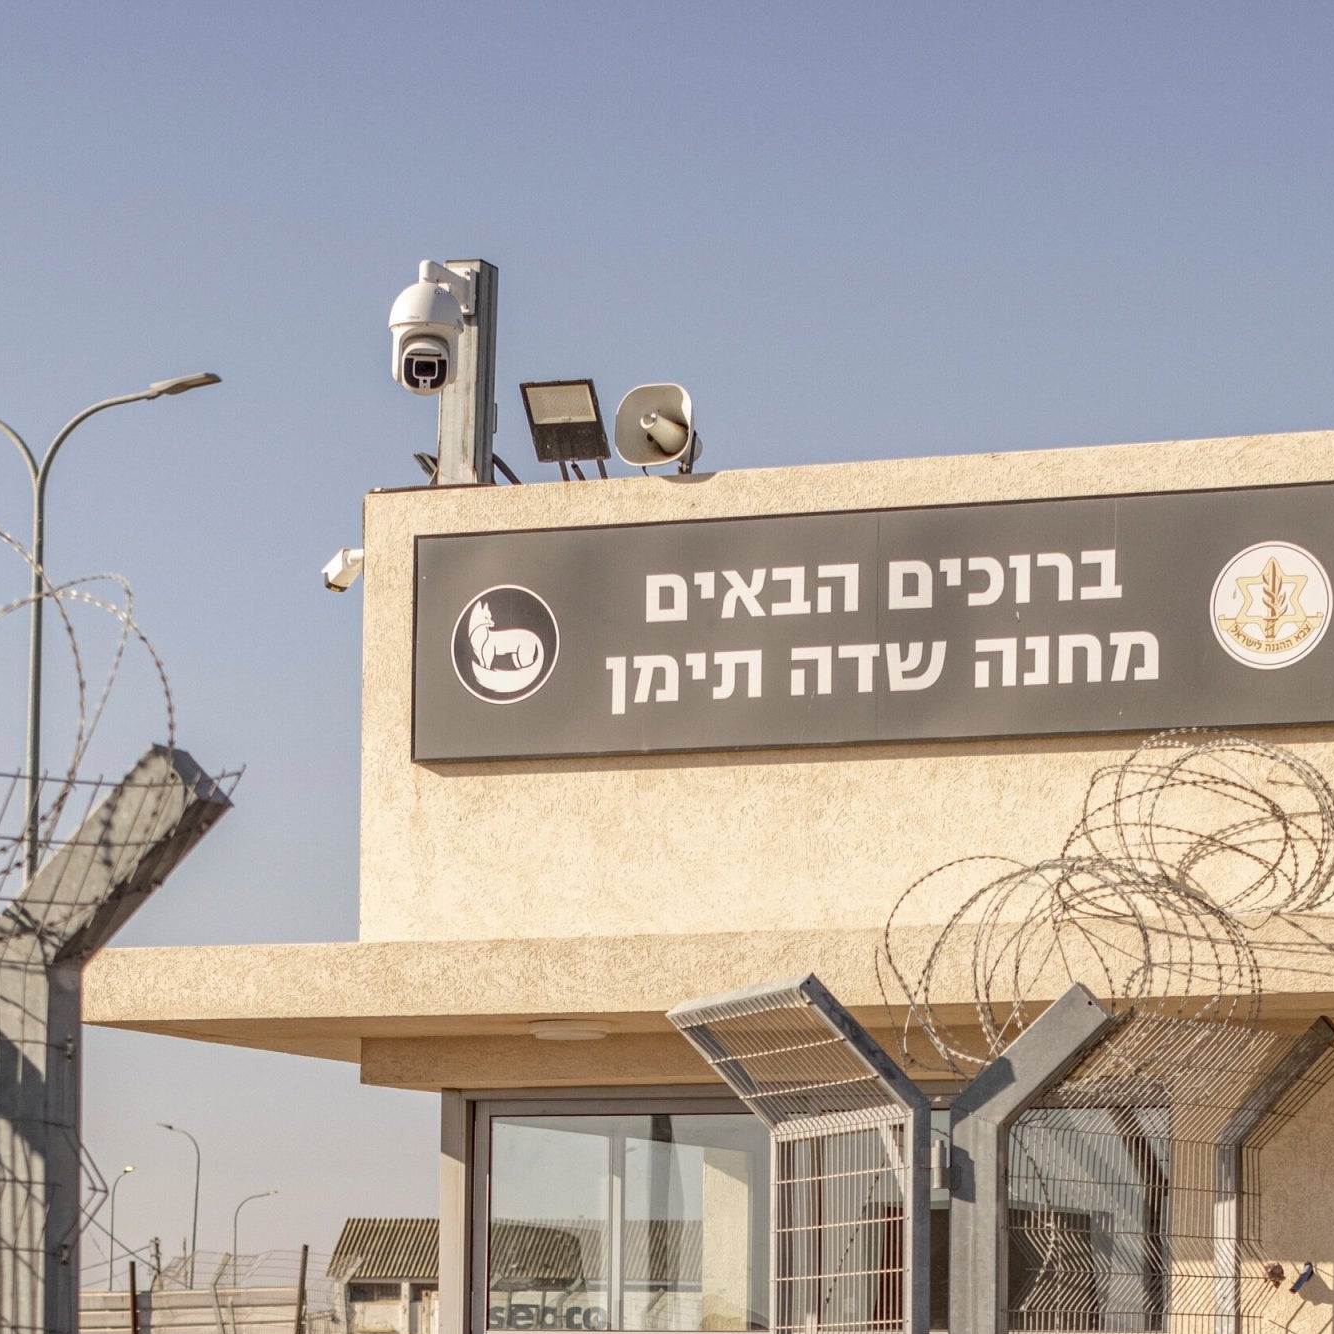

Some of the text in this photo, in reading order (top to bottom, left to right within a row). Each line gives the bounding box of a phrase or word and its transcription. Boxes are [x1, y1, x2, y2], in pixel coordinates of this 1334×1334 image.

[645, 548, 1123, 623] ברוכים הבאים
[605, 630, 1159, 715] מחנה שדה תימן
[1230, 624, 1312, 652] צבא ההגנה לישראל
